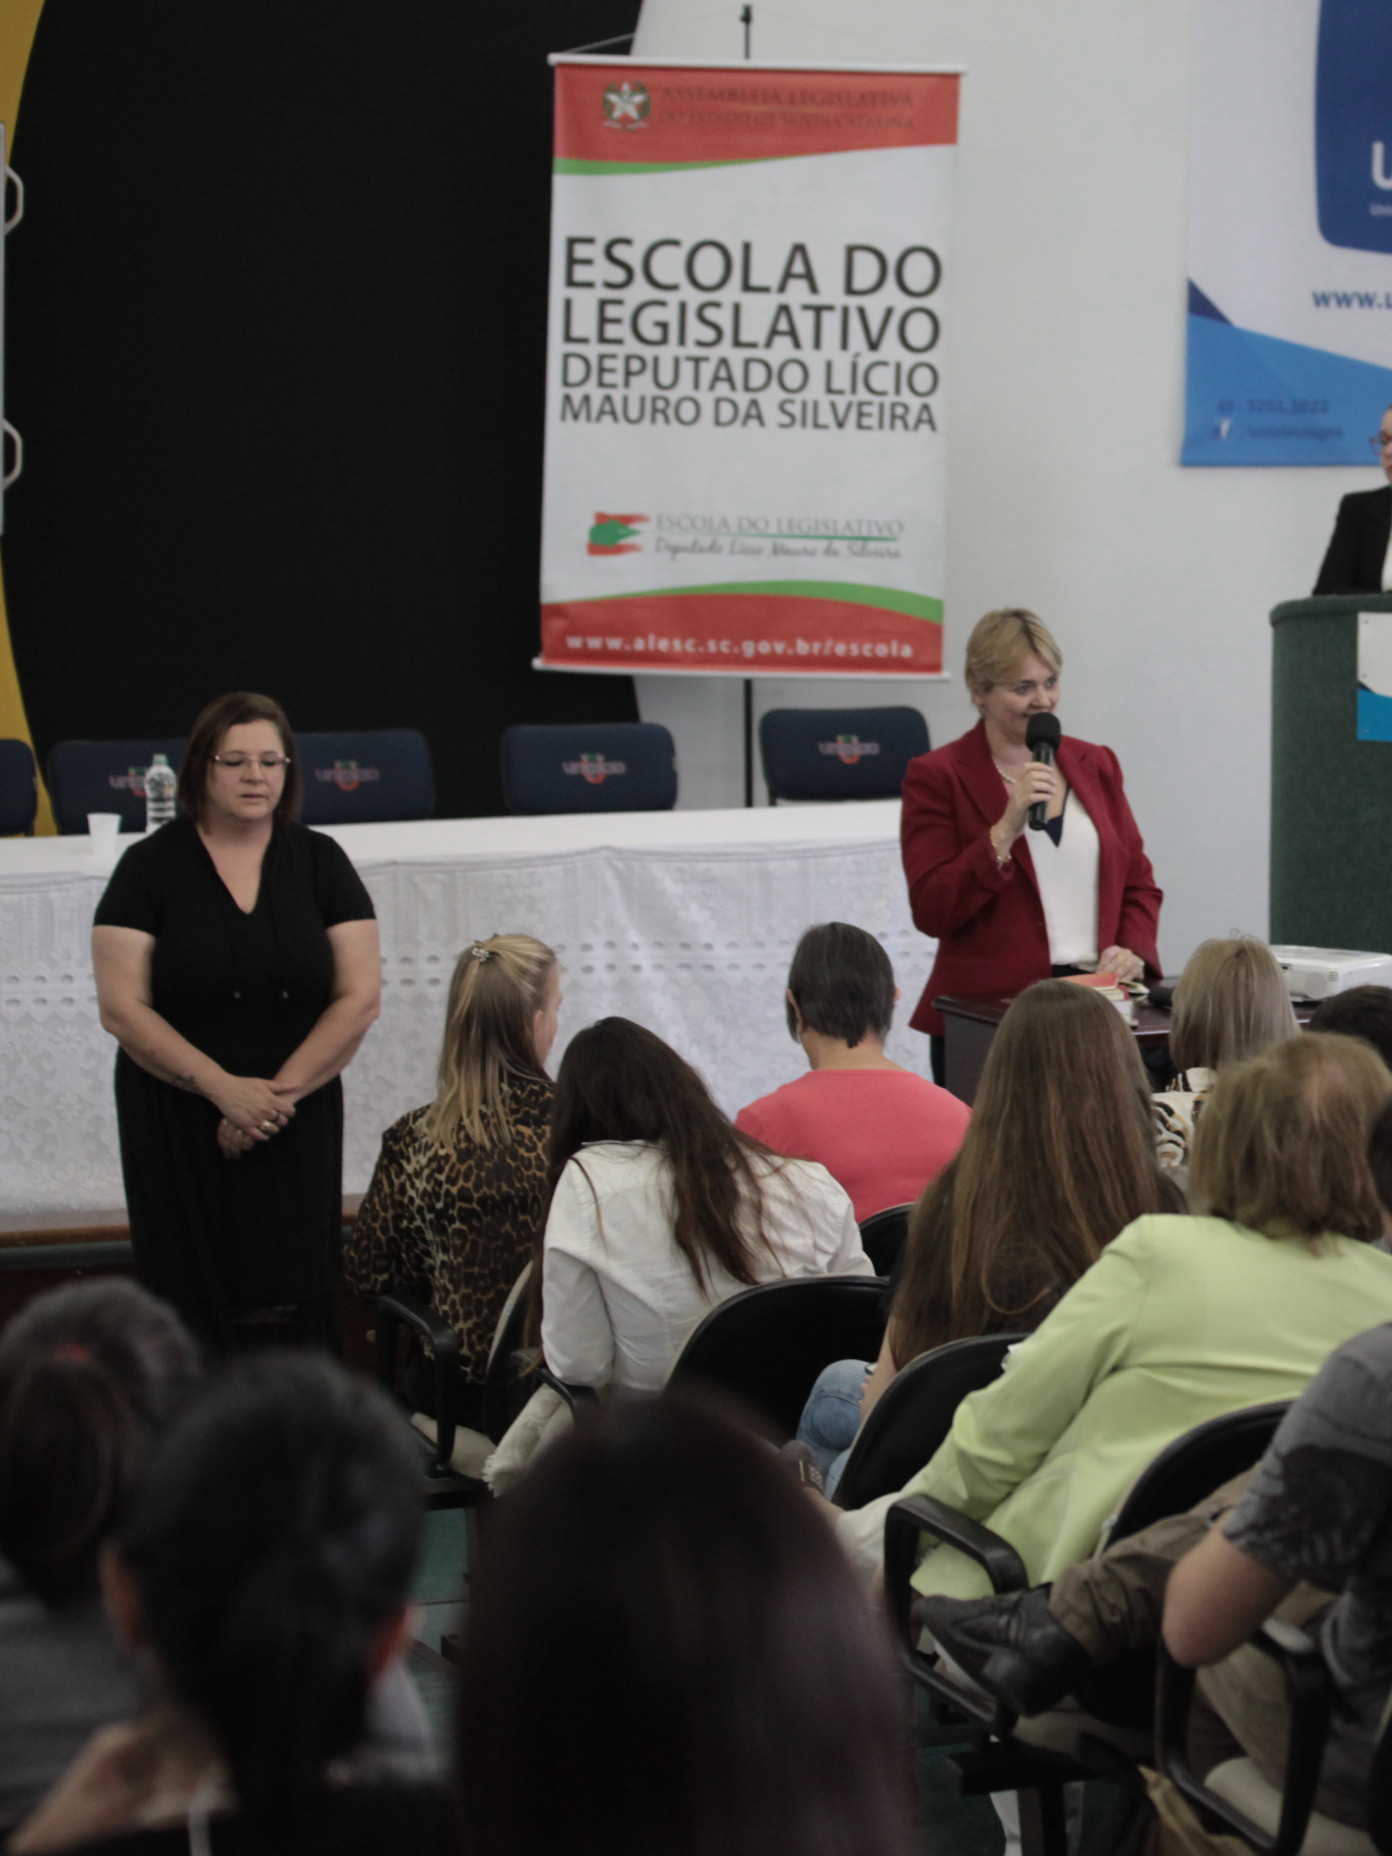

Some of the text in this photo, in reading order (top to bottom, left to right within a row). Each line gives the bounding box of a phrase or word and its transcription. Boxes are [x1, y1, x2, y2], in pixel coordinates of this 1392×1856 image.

[563, 236, 943, 298] ESCOLA DO
[562, 297, 941, 354] LEGISLATIVO
[560, 352, 940, 398] DEPUTADO LÍCIO
[559, 393, 938, 433] MAURO DA SILVEIRA
[655, 514, 905, 537] ESCOLA DO LEGISLATIVO
[565, 634, 913, 658] www.alesc.sc.gov.br/escola
